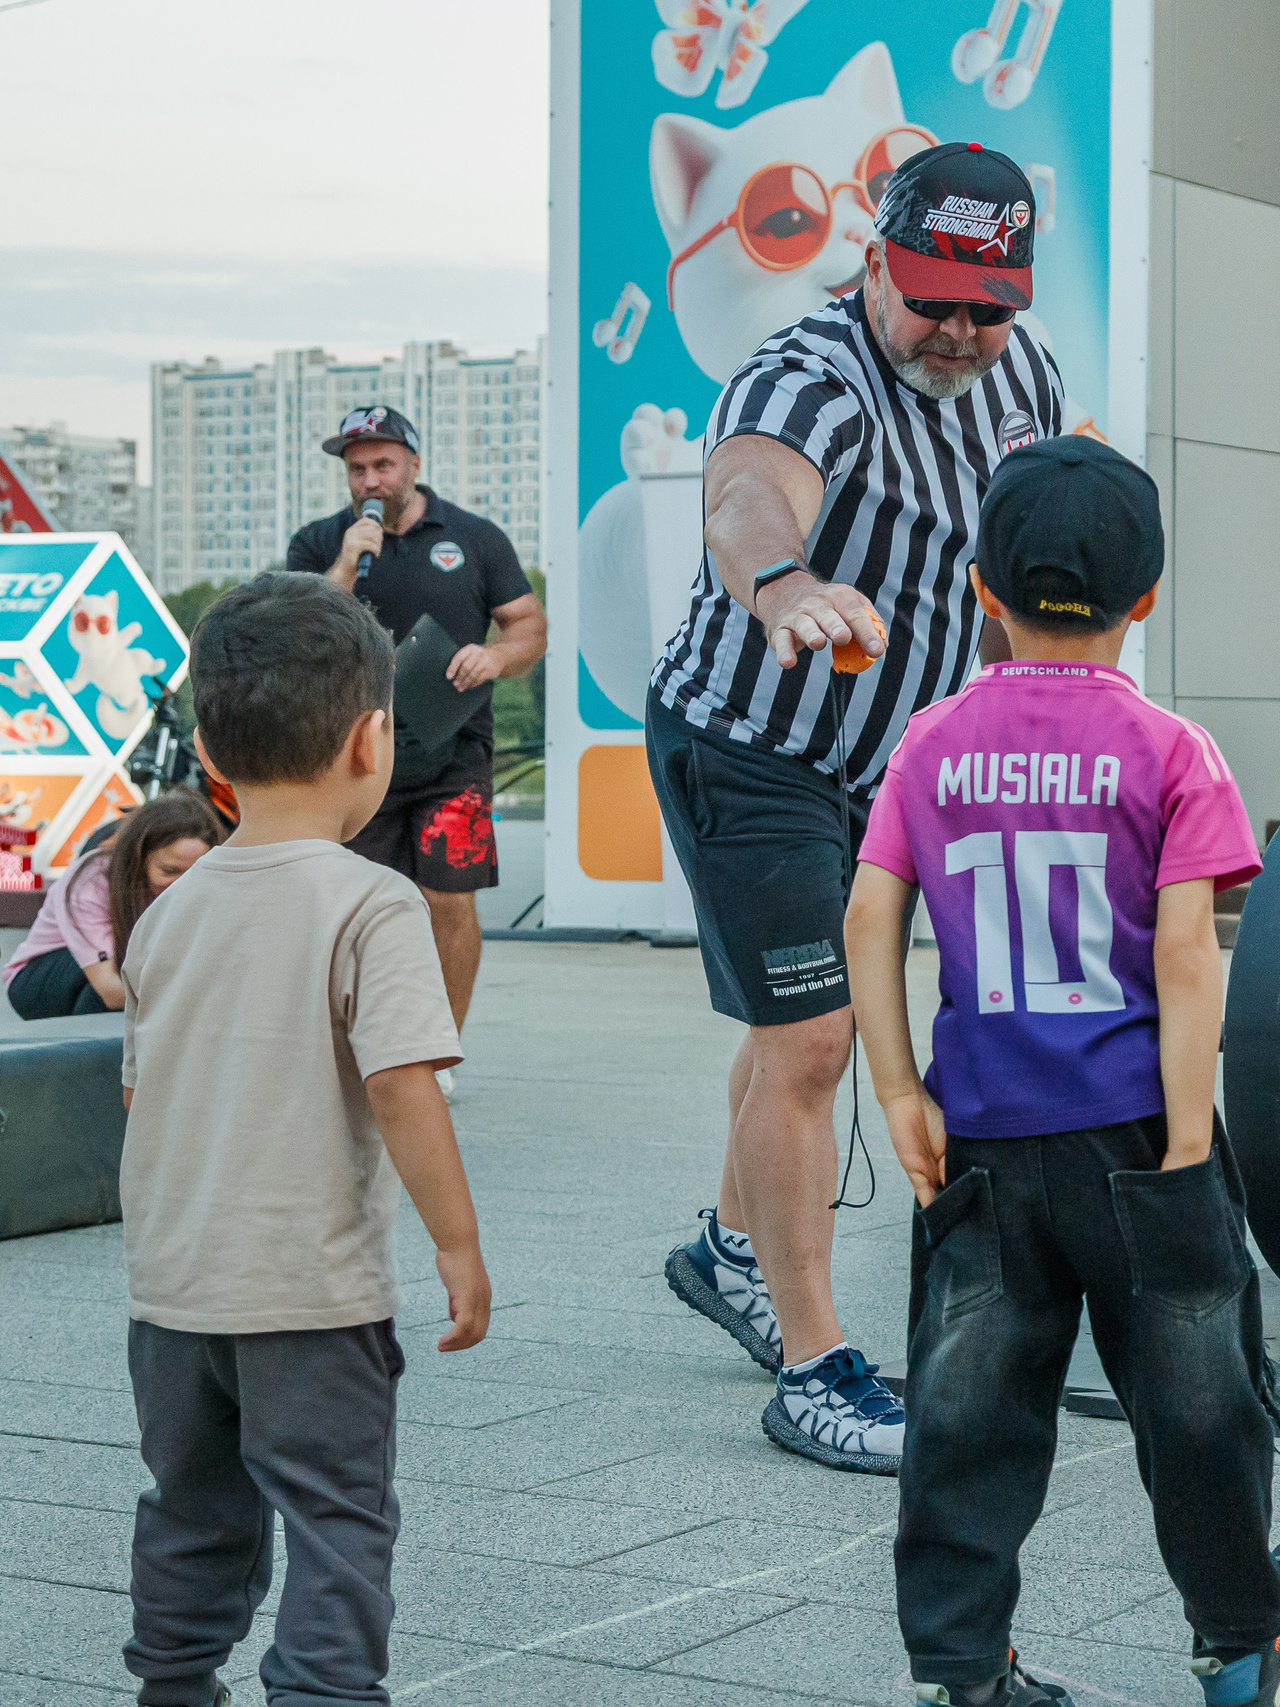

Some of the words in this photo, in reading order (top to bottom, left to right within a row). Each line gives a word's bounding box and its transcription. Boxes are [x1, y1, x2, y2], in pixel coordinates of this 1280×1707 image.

[939, 195, 998, 220] RUSSIAN
[921, 214, 999, 241] STRONGMAN
[0, 572, 64, 597] ЕТО
[1001, 666, 1089, 677] DEUTSCHLAND
[937, 752, 1121, 806] MUSIALA
[945, 830, 1126, 1014] 10
[767, 965, 791, 975] FITNESS
[772, 982, 807, 997] Beyond
[807, 979, 824, 991] the
[823, 974, 844, 987] Burn
